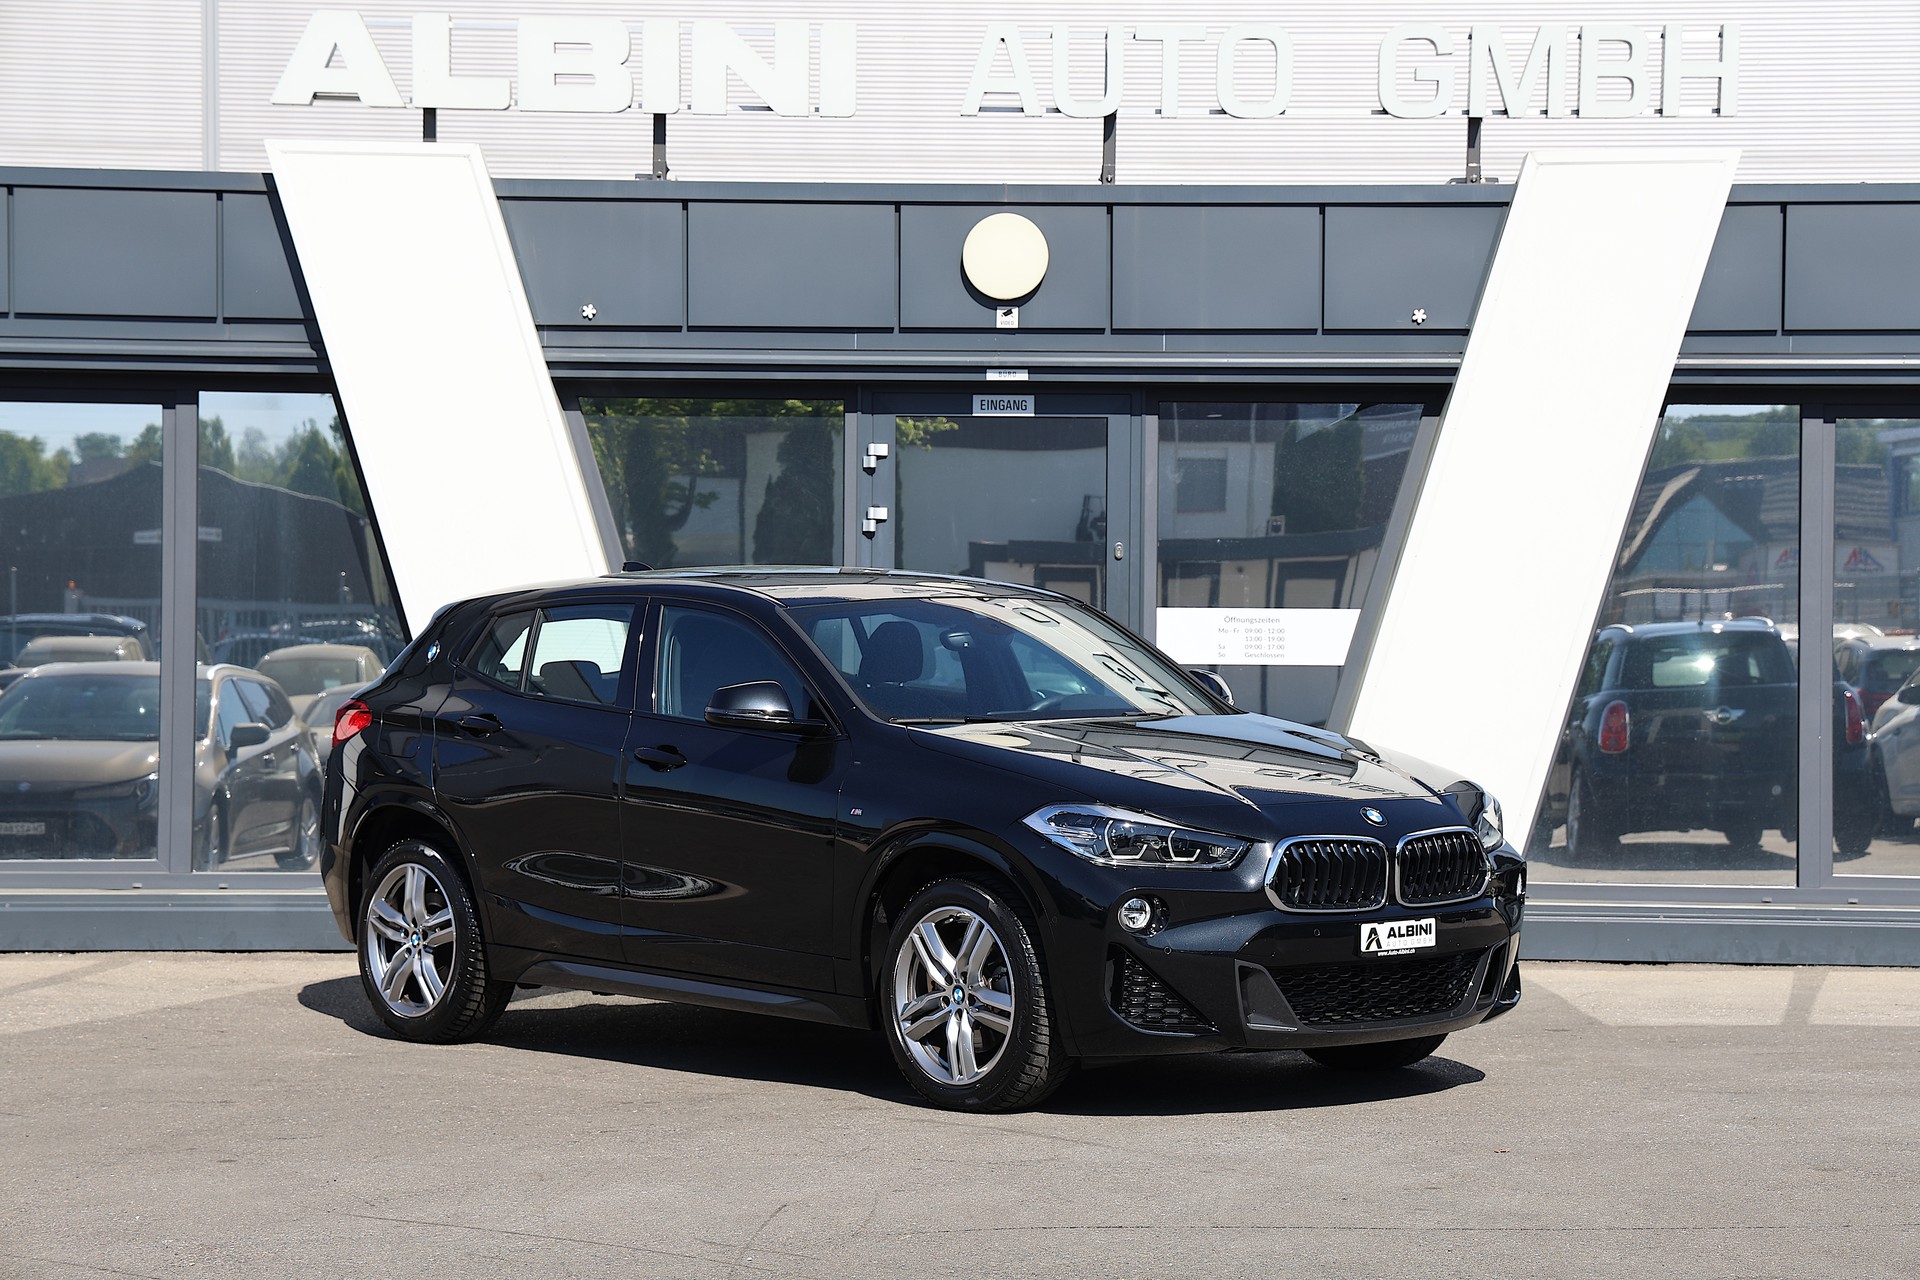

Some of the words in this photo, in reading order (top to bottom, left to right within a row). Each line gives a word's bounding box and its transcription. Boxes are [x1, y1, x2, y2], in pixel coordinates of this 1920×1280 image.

[271, 9, 858, 118] ALBINI
[960, 24, 1294, 119] AUTO
[1377, 24, 1741, 119] GMBH
[980, 399, 1028, 411] EINGANG
[1224, 616, 1280, 624] Öffnungszeiten
[1387, 923, 1432, 939] ALBINI
